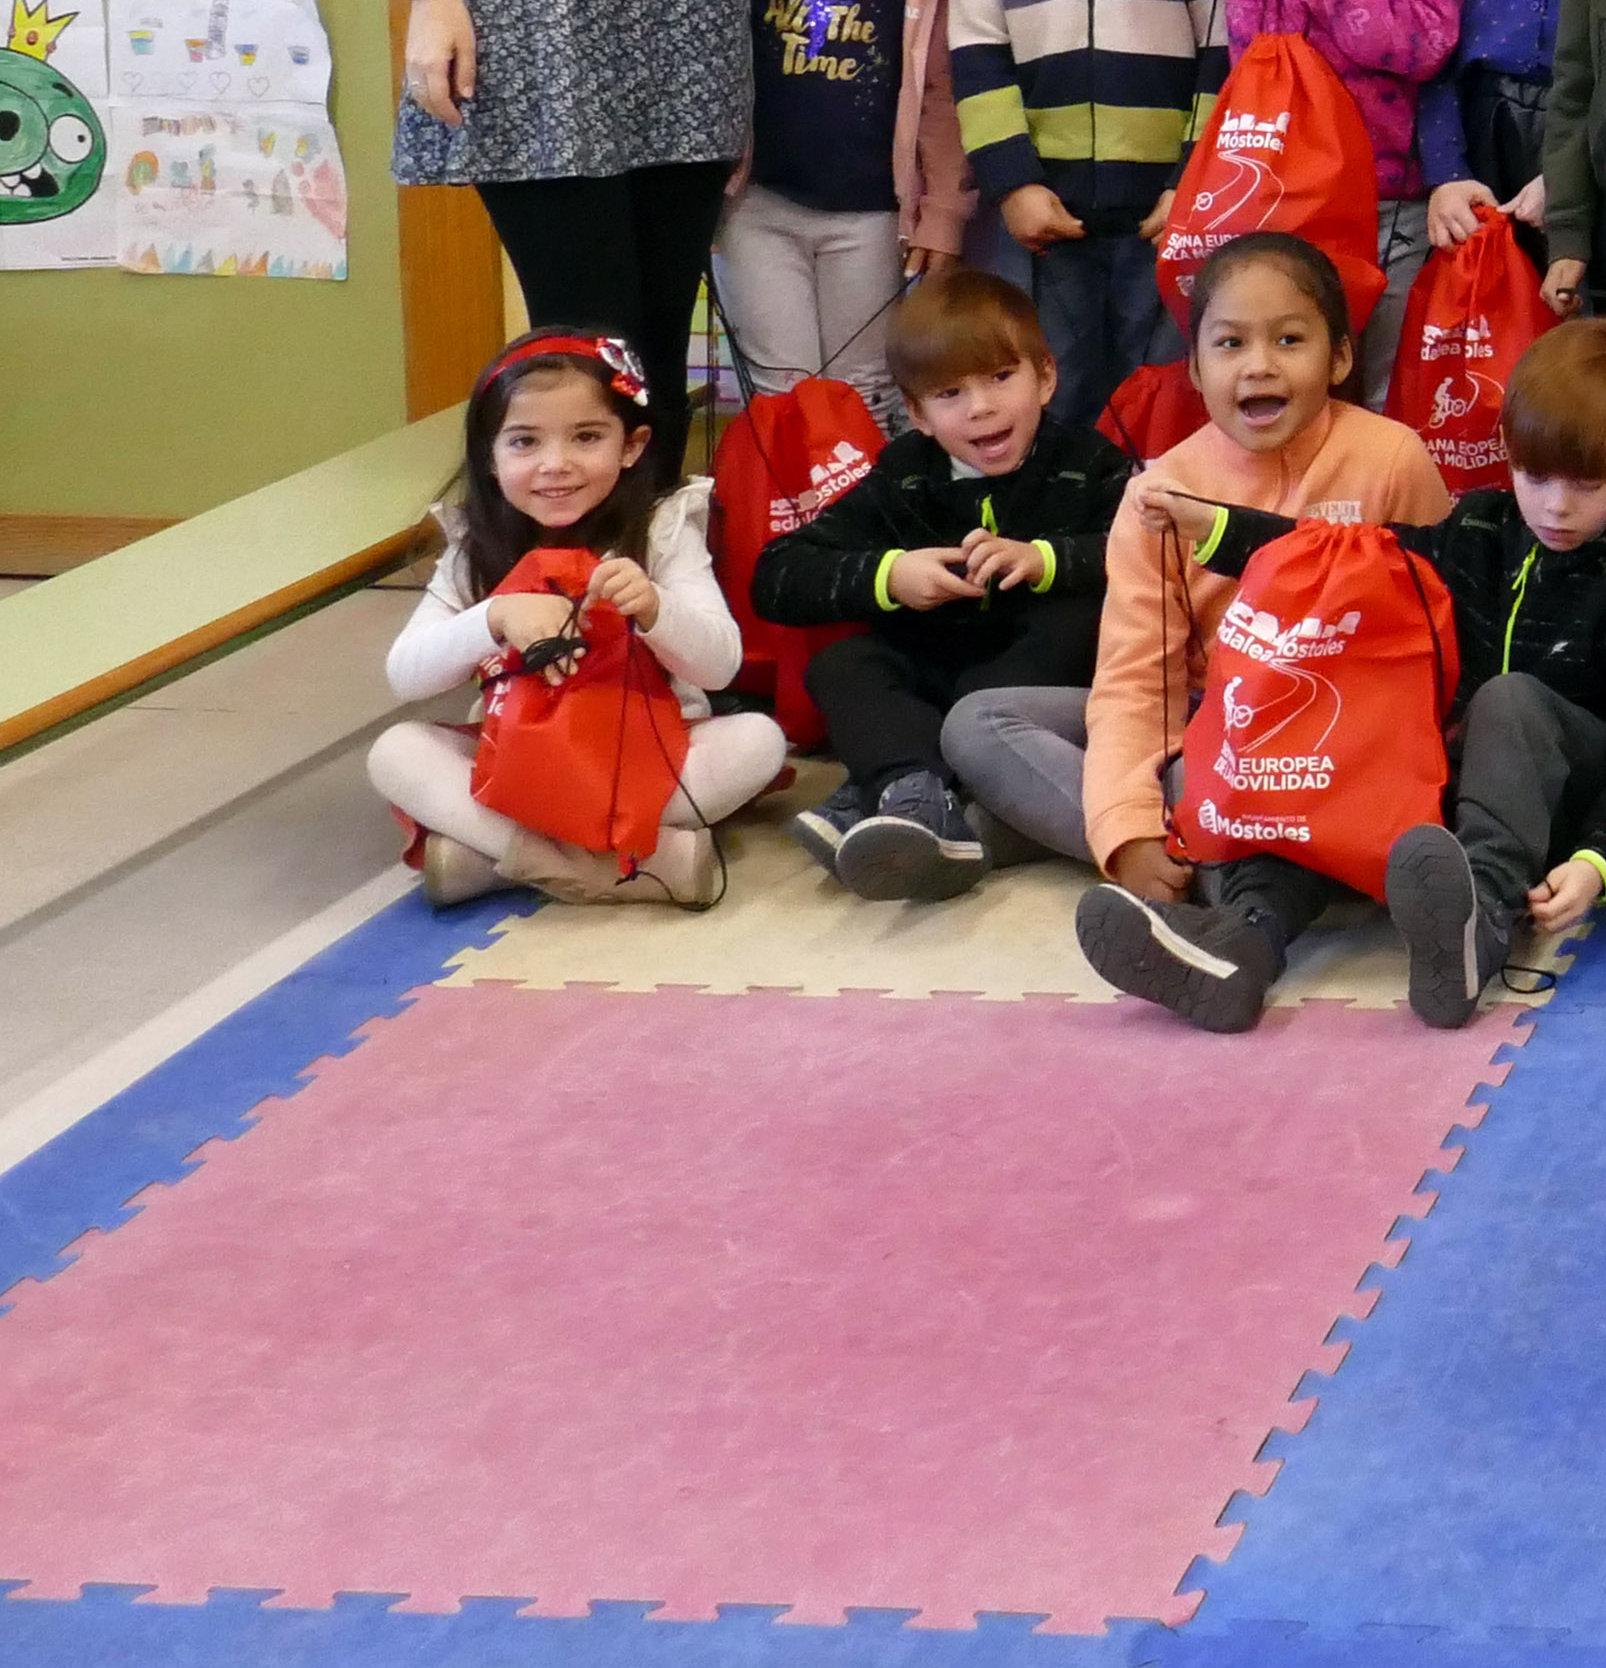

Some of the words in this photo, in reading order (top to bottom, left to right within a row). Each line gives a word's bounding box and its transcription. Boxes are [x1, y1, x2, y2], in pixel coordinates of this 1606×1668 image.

[827, 4, 876, 44] The
[781, 31, 866, 81] Time
[1238, 755, 1335, 775] EUROPEA
[1217, 814, 1312, 843] Móstoles
